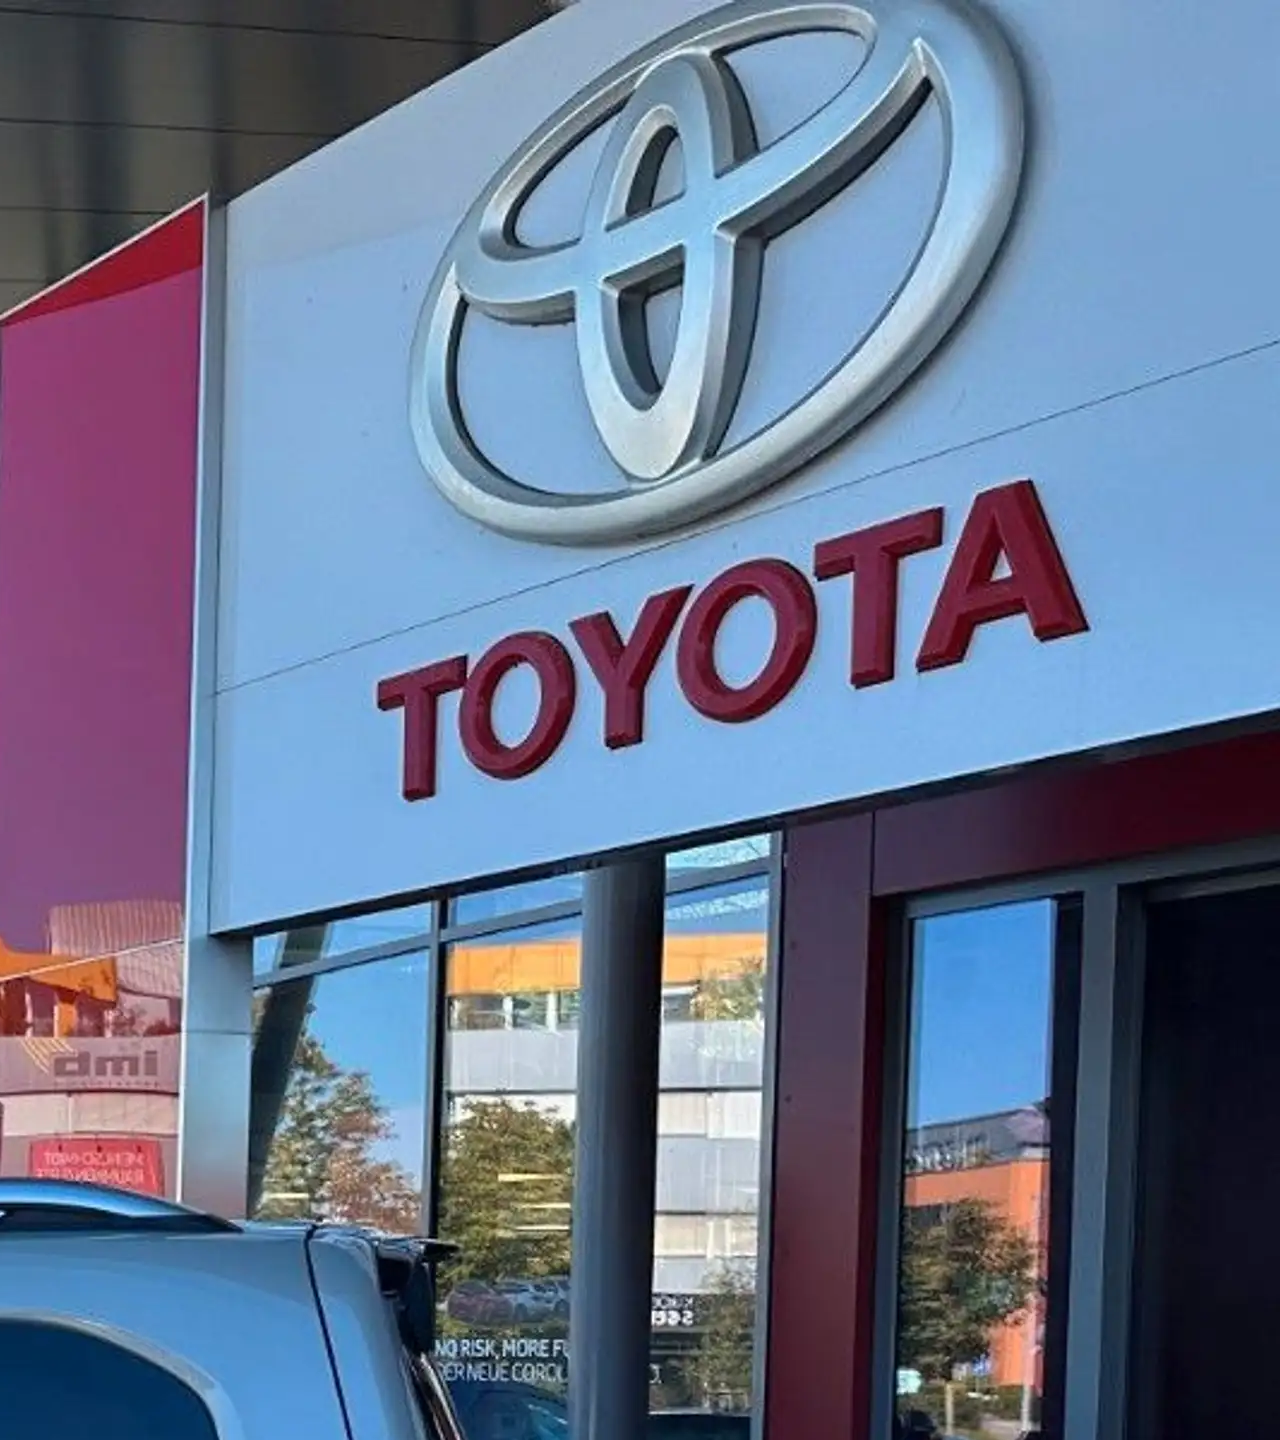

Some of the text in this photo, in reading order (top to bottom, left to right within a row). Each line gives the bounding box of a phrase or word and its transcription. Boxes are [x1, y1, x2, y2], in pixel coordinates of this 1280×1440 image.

[375, 479, 1089, 802] TOYOTA
[434, 1340, 458, 1358] NO
[460, 1340, 499, 1360] RISK,
[502, 1340, 550, 1358] MORE
[467, 1363, 510, 1381] NEUE
